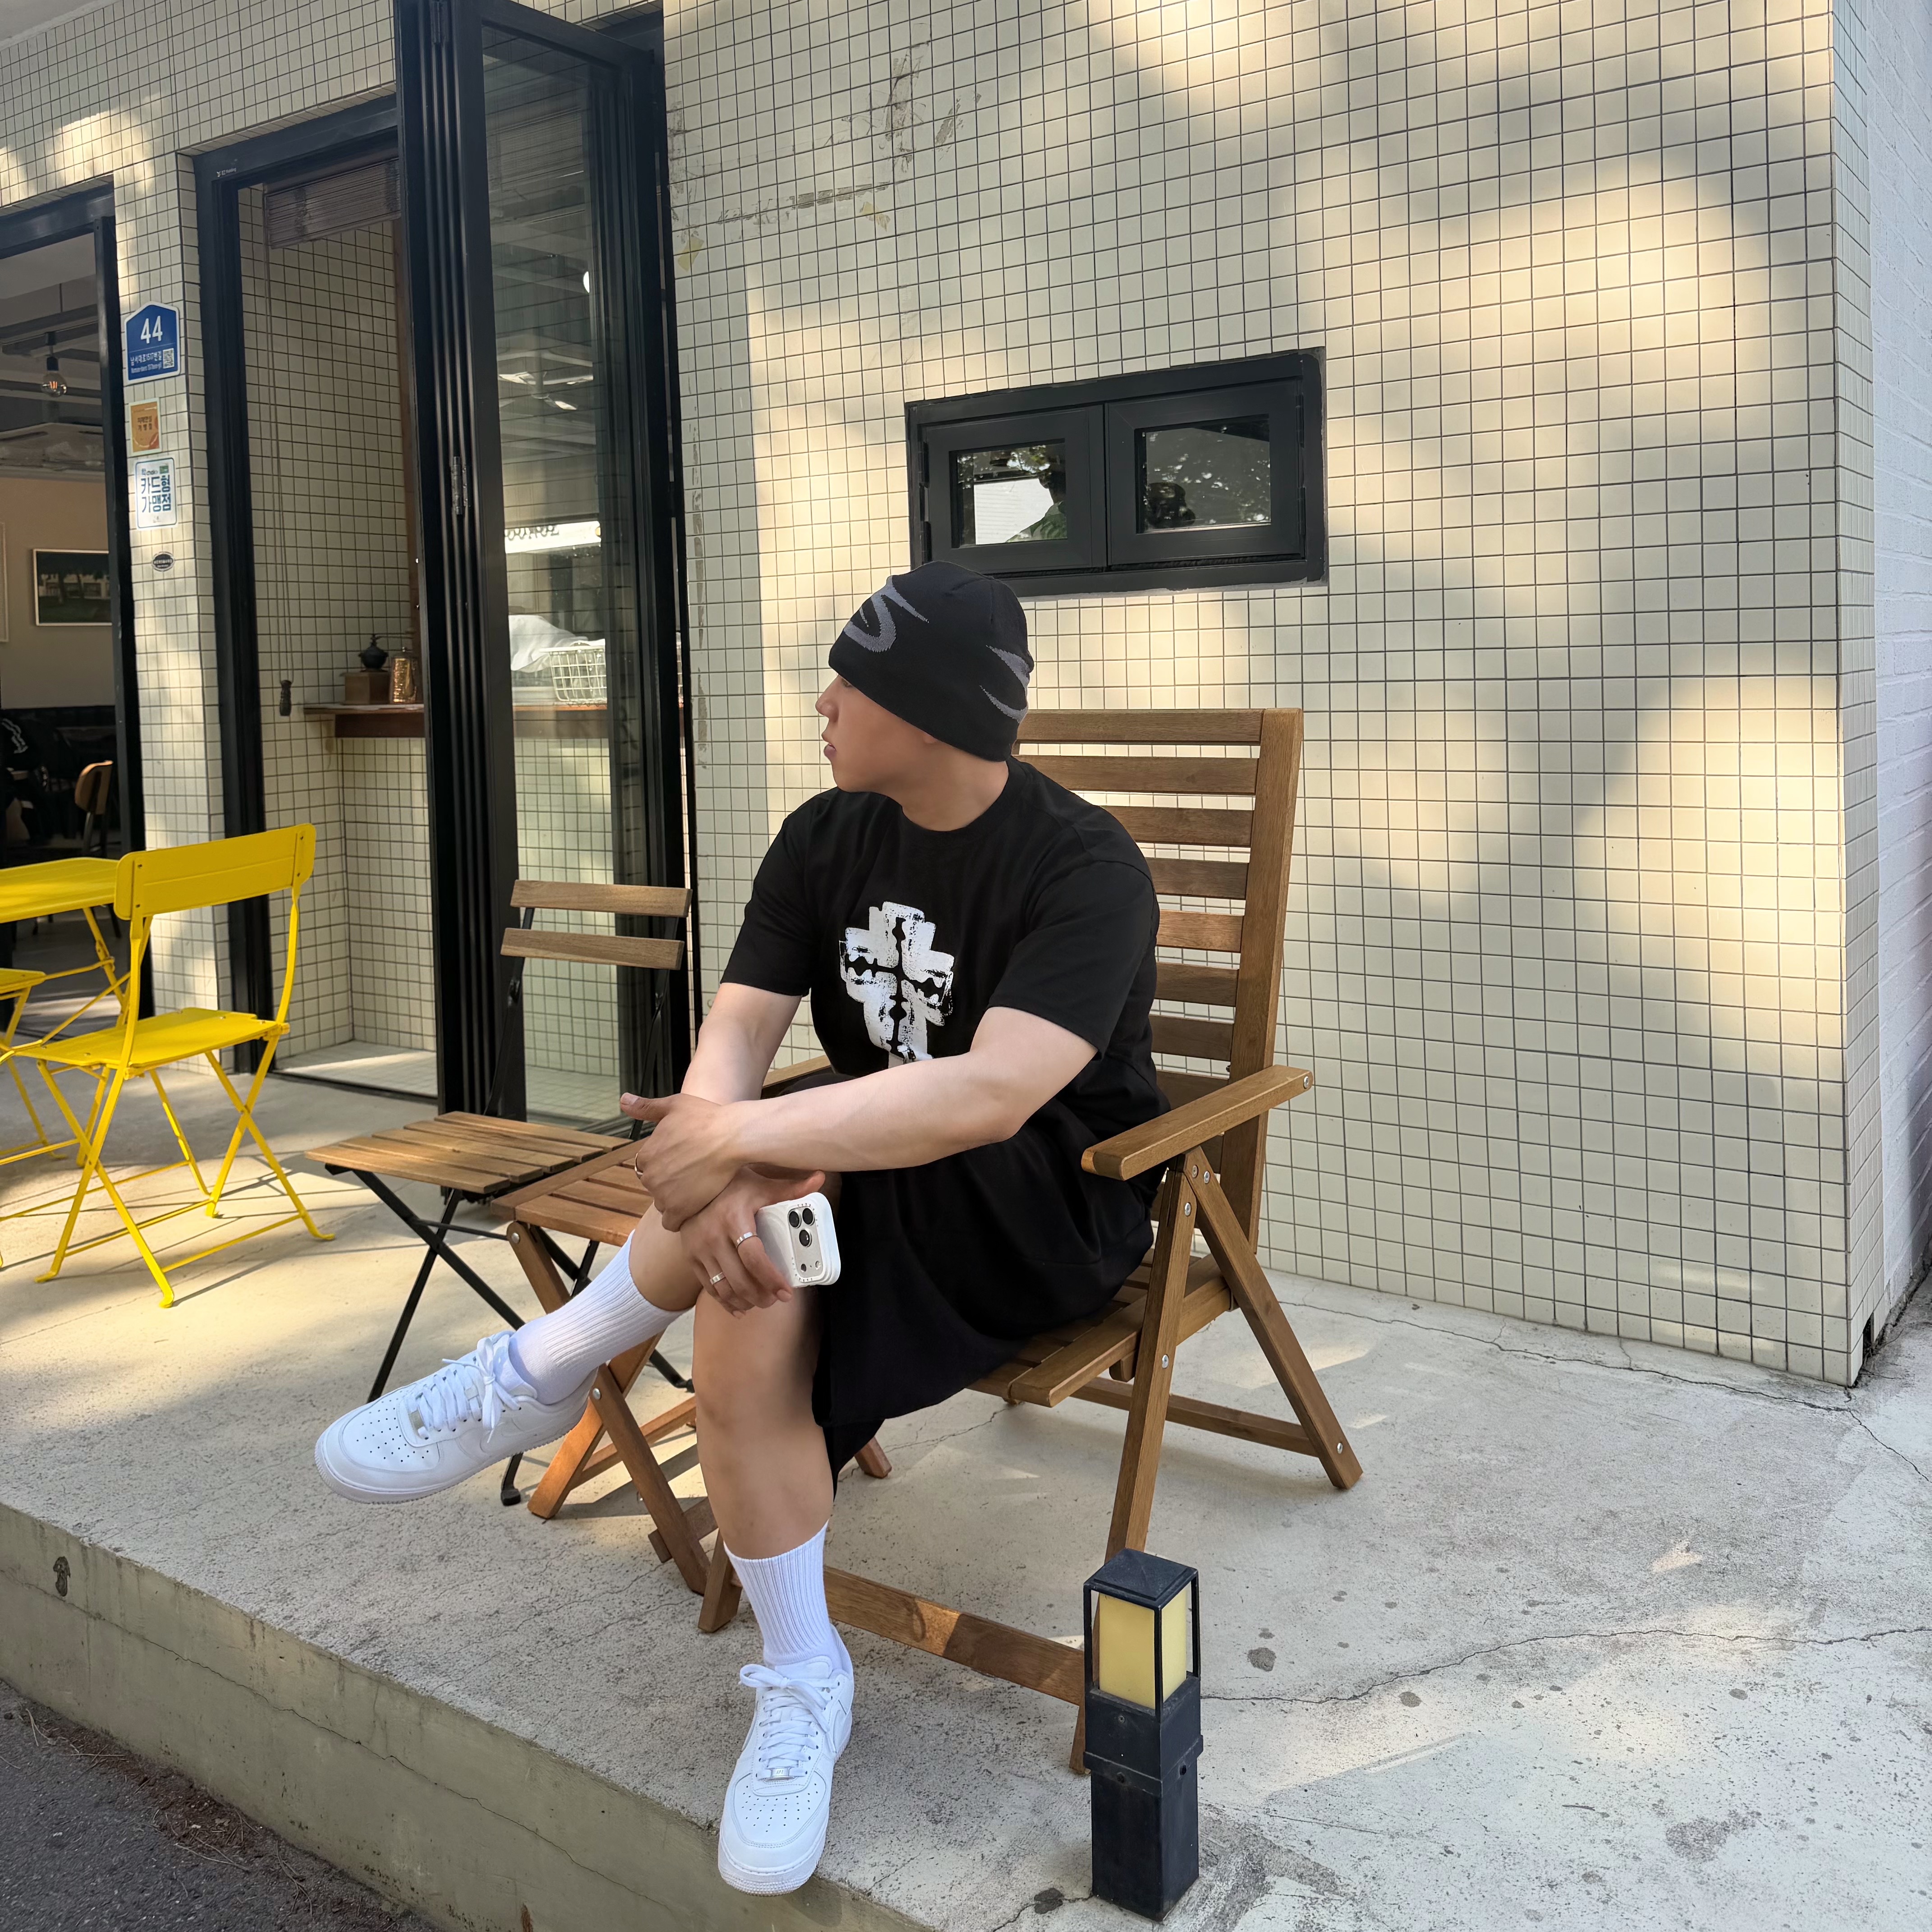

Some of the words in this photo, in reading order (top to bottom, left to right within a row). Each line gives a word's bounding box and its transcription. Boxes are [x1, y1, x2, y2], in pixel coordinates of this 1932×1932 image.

[141, 316, 163, 344] 44
[141, 474, 170, 494] 카드형
[142, 493, 171, 513] 가맹점
